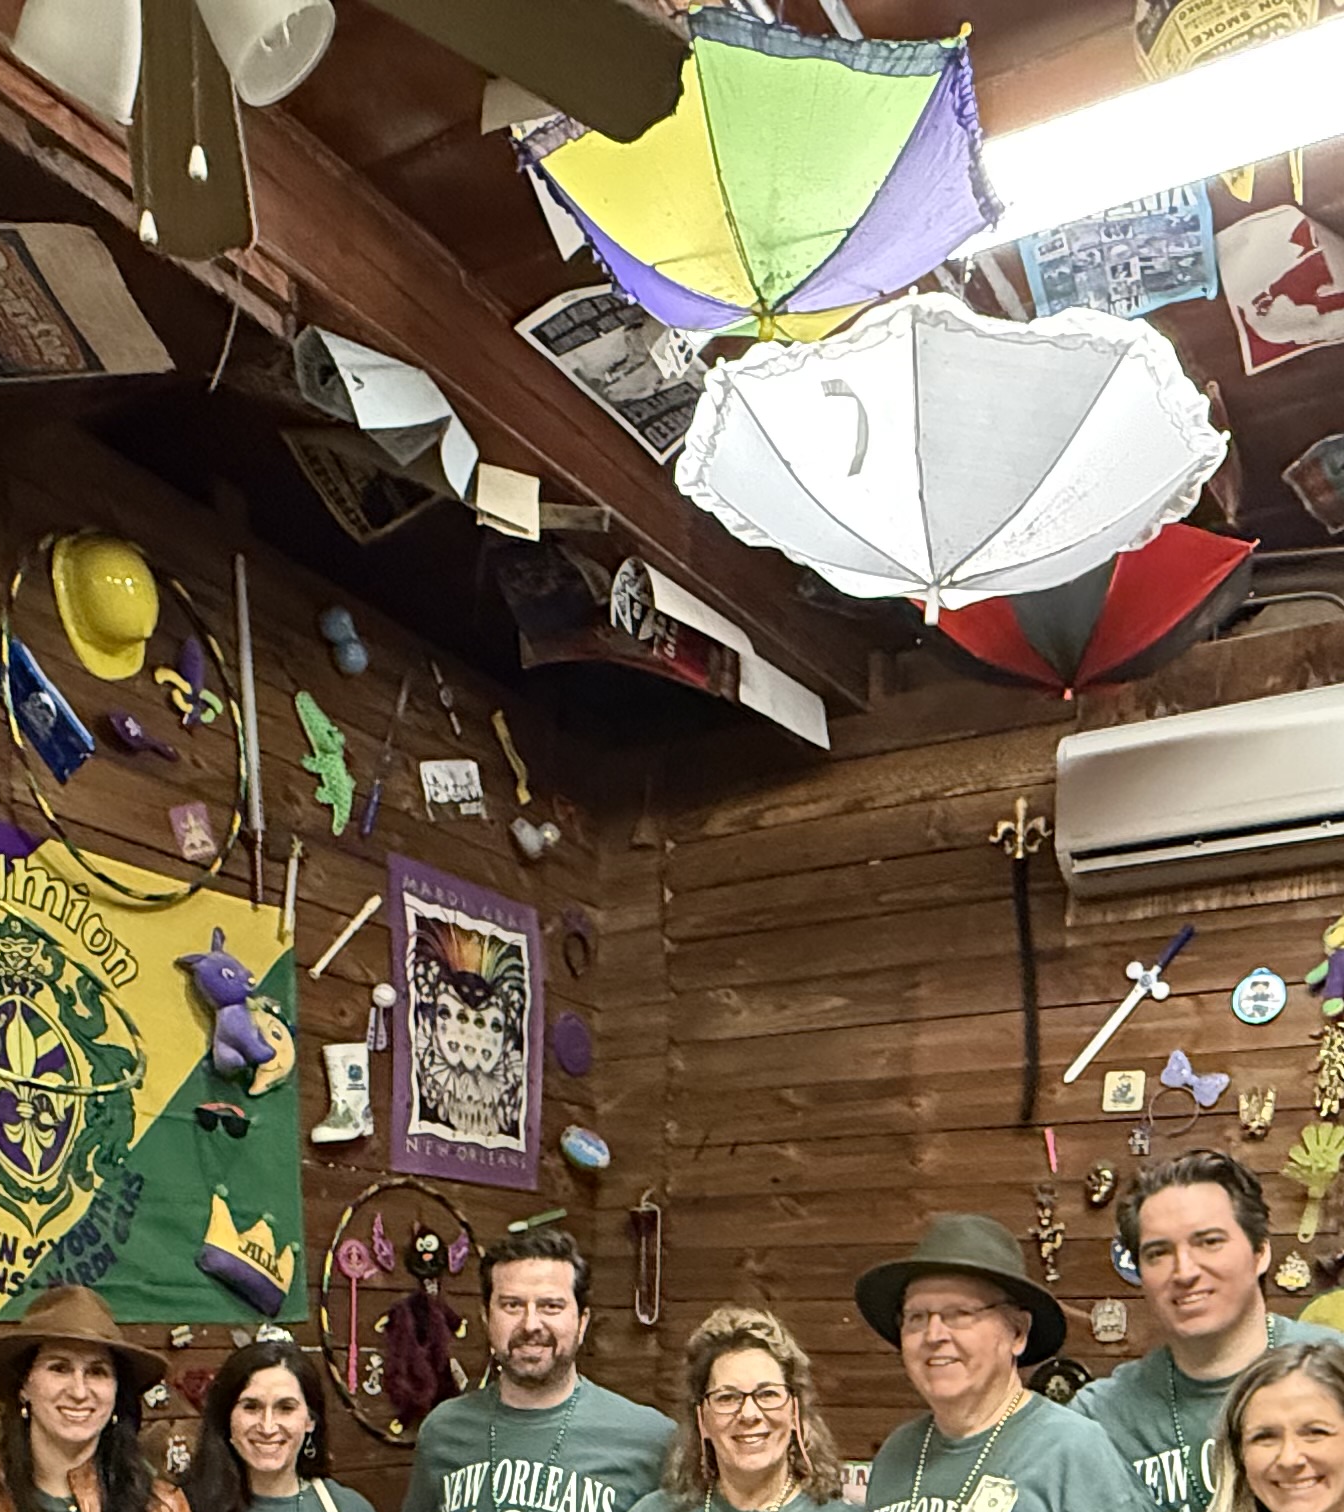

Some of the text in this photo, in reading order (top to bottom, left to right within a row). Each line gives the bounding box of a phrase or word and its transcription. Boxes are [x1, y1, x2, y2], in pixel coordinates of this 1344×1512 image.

[1191, 10, 1252, 48] SMOKE
[403, 874, 467, 909] MARDI
[405, 1137, 452, 1157] NEW
[48, 1188, 114, 1265] YOUTH
